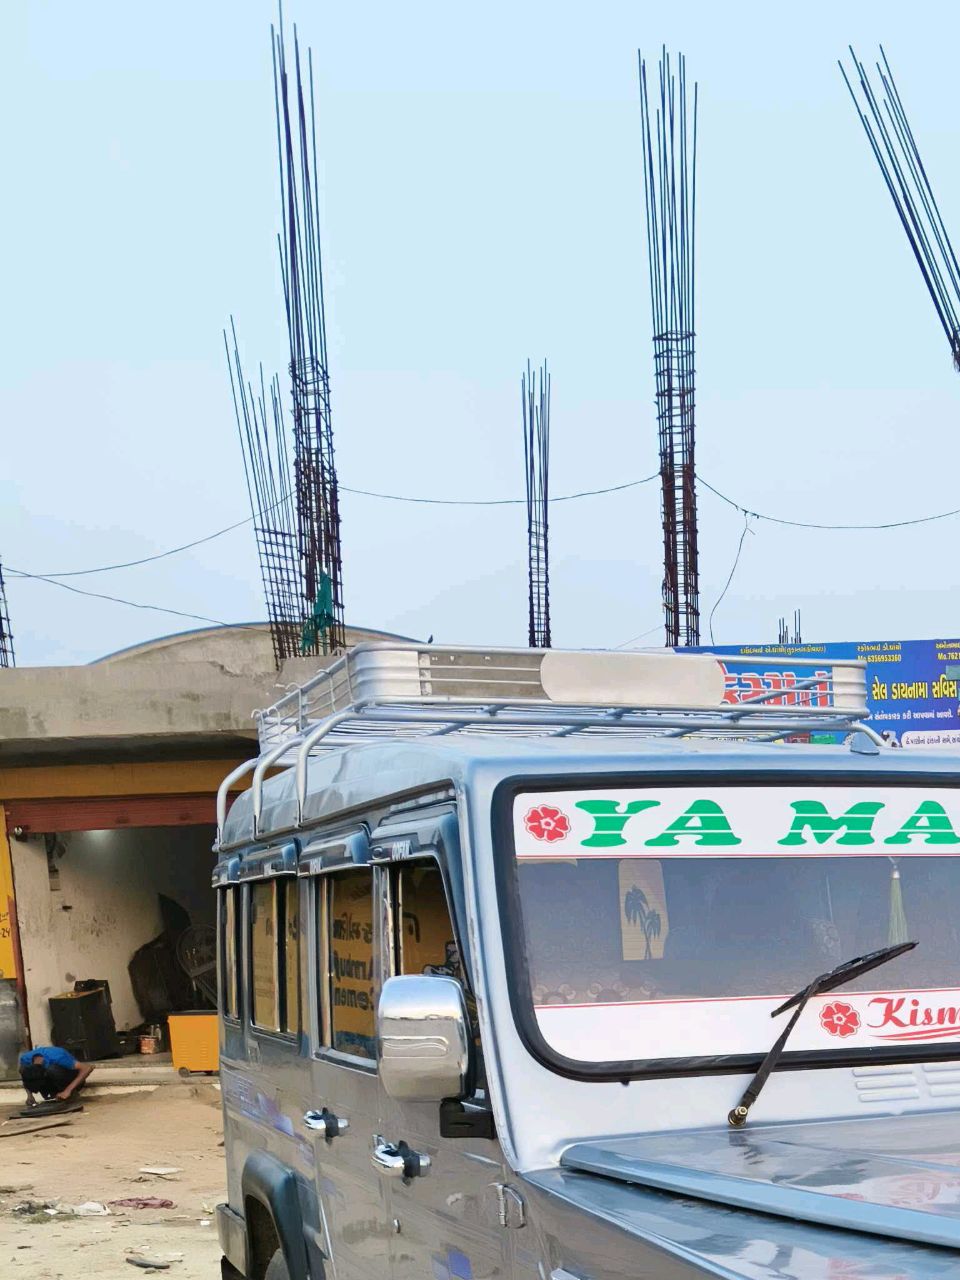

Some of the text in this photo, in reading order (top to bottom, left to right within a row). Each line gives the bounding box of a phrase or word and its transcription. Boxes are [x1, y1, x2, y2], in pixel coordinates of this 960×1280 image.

[872, 675, 888, 700] સેલ
[891, 681, 928, 700] ડાયનામા
[575, 799, 742, 847] YA
